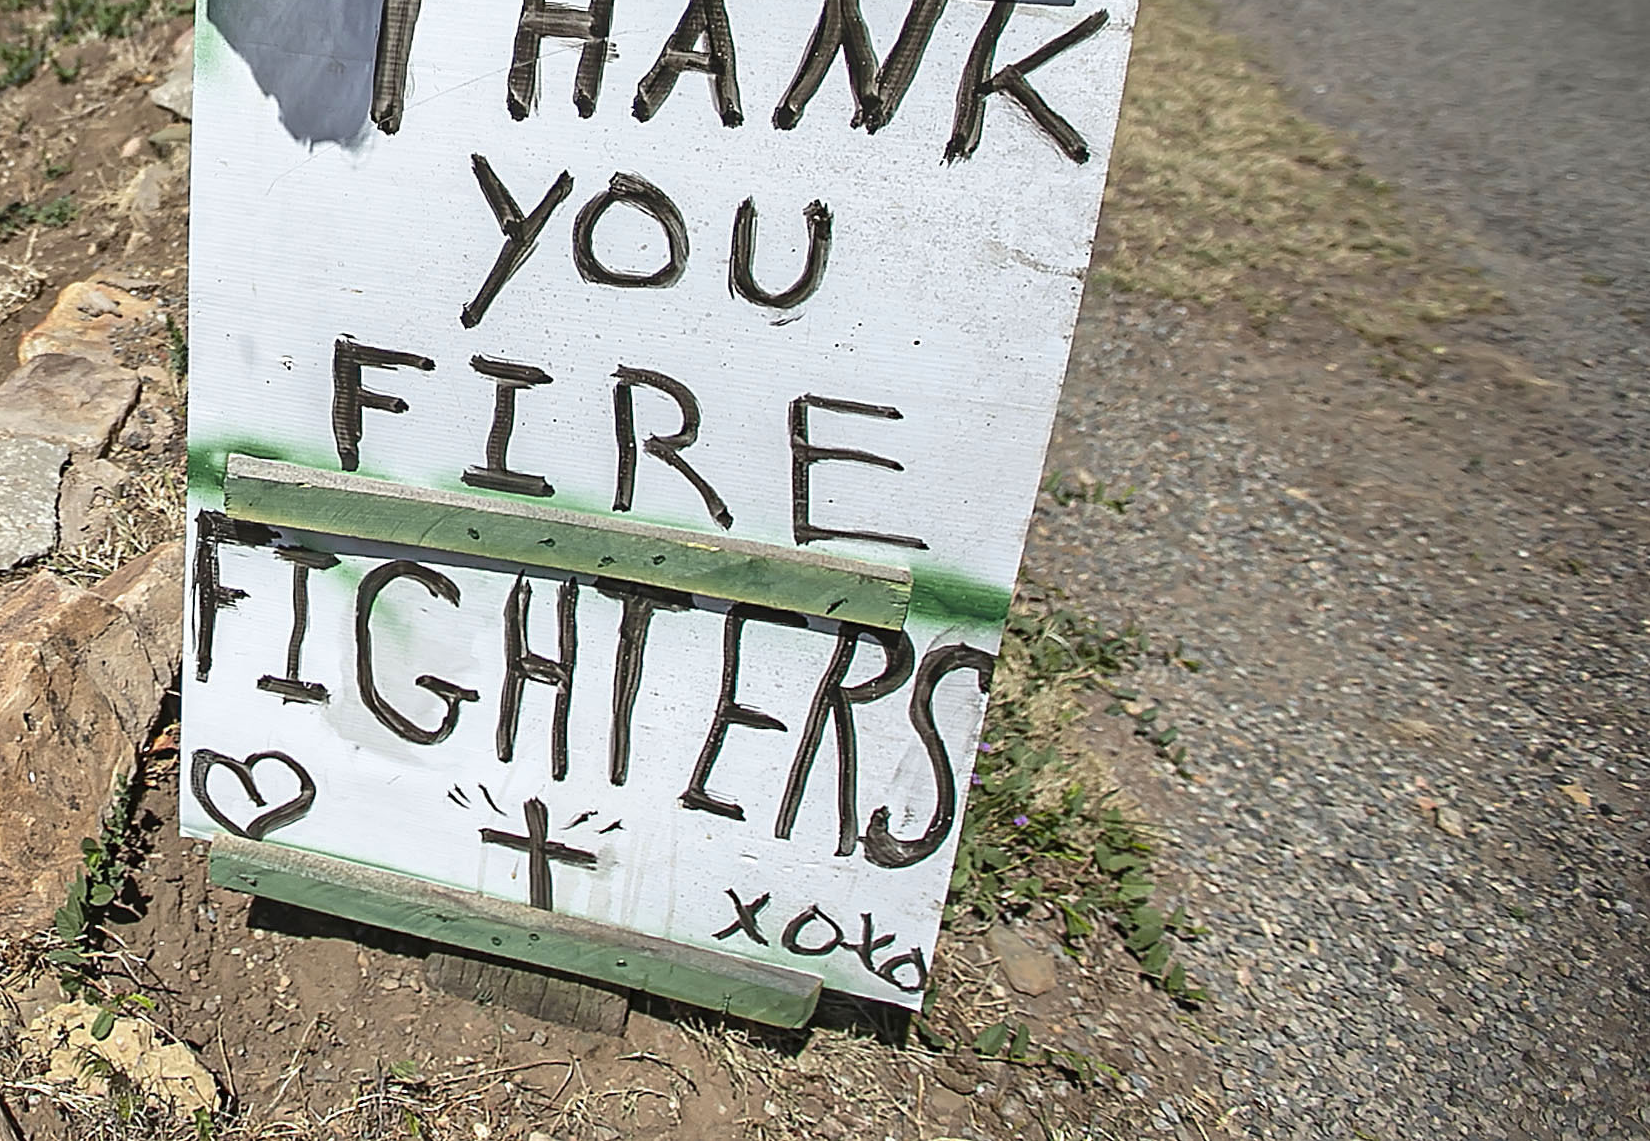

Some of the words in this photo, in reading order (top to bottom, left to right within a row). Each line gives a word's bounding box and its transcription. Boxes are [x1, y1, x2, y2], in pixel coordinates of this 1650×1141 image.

[459, 152, 834, 329] YOU
[331, 333, 929, 551] FIRE
[192, 510, 997, 870] FIGHTERS
